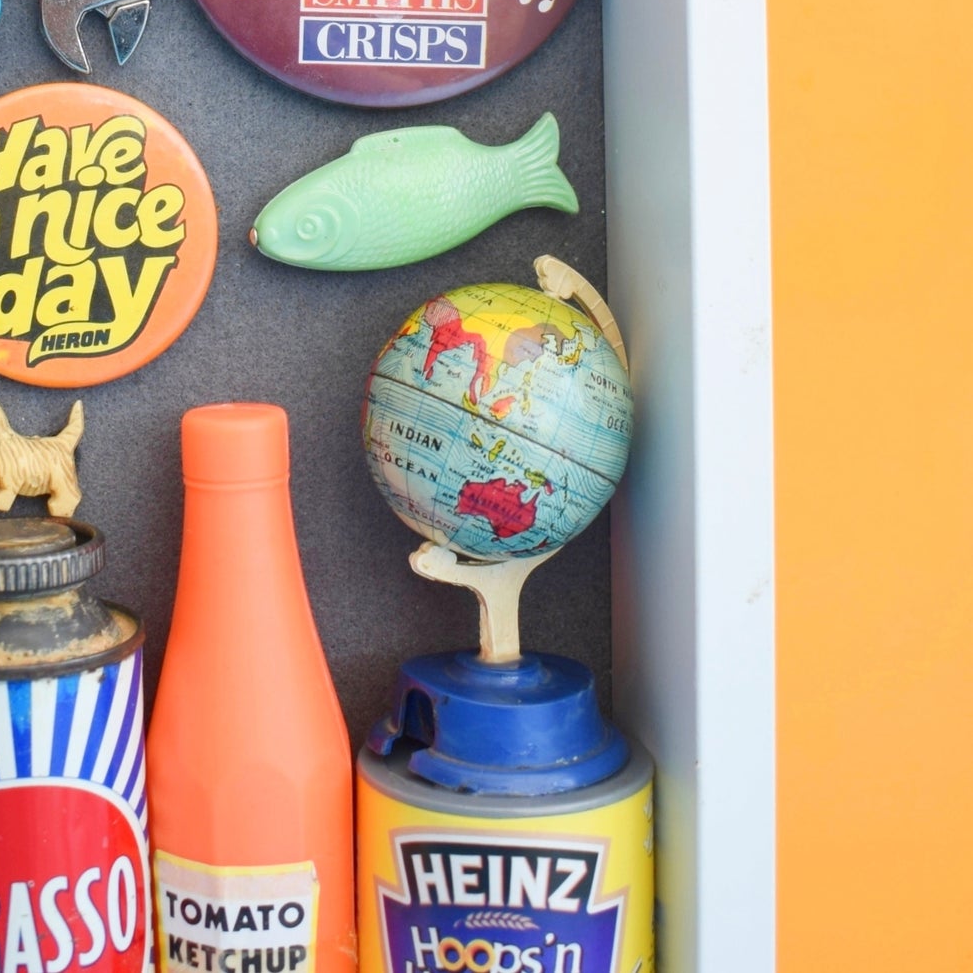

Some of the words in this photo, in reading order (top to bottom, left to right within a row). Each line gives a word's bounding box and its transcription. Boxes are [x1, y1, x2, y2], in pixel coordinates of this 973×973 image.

[316, 22, 467, 63] CRISPS
[10, 165, 186, 265] nice
[40, 328, 111, 352] HERON
[590, 372, 619, 394] NORTH
[389, 421, 442, 452] INDIAN
[384, 451, 438, 482] OCEAN
[410, 853, 590, 914] HEINZ
[166, 890, 305, 932] TOMATO
[169, 933, 307, 973] KETCHUP
